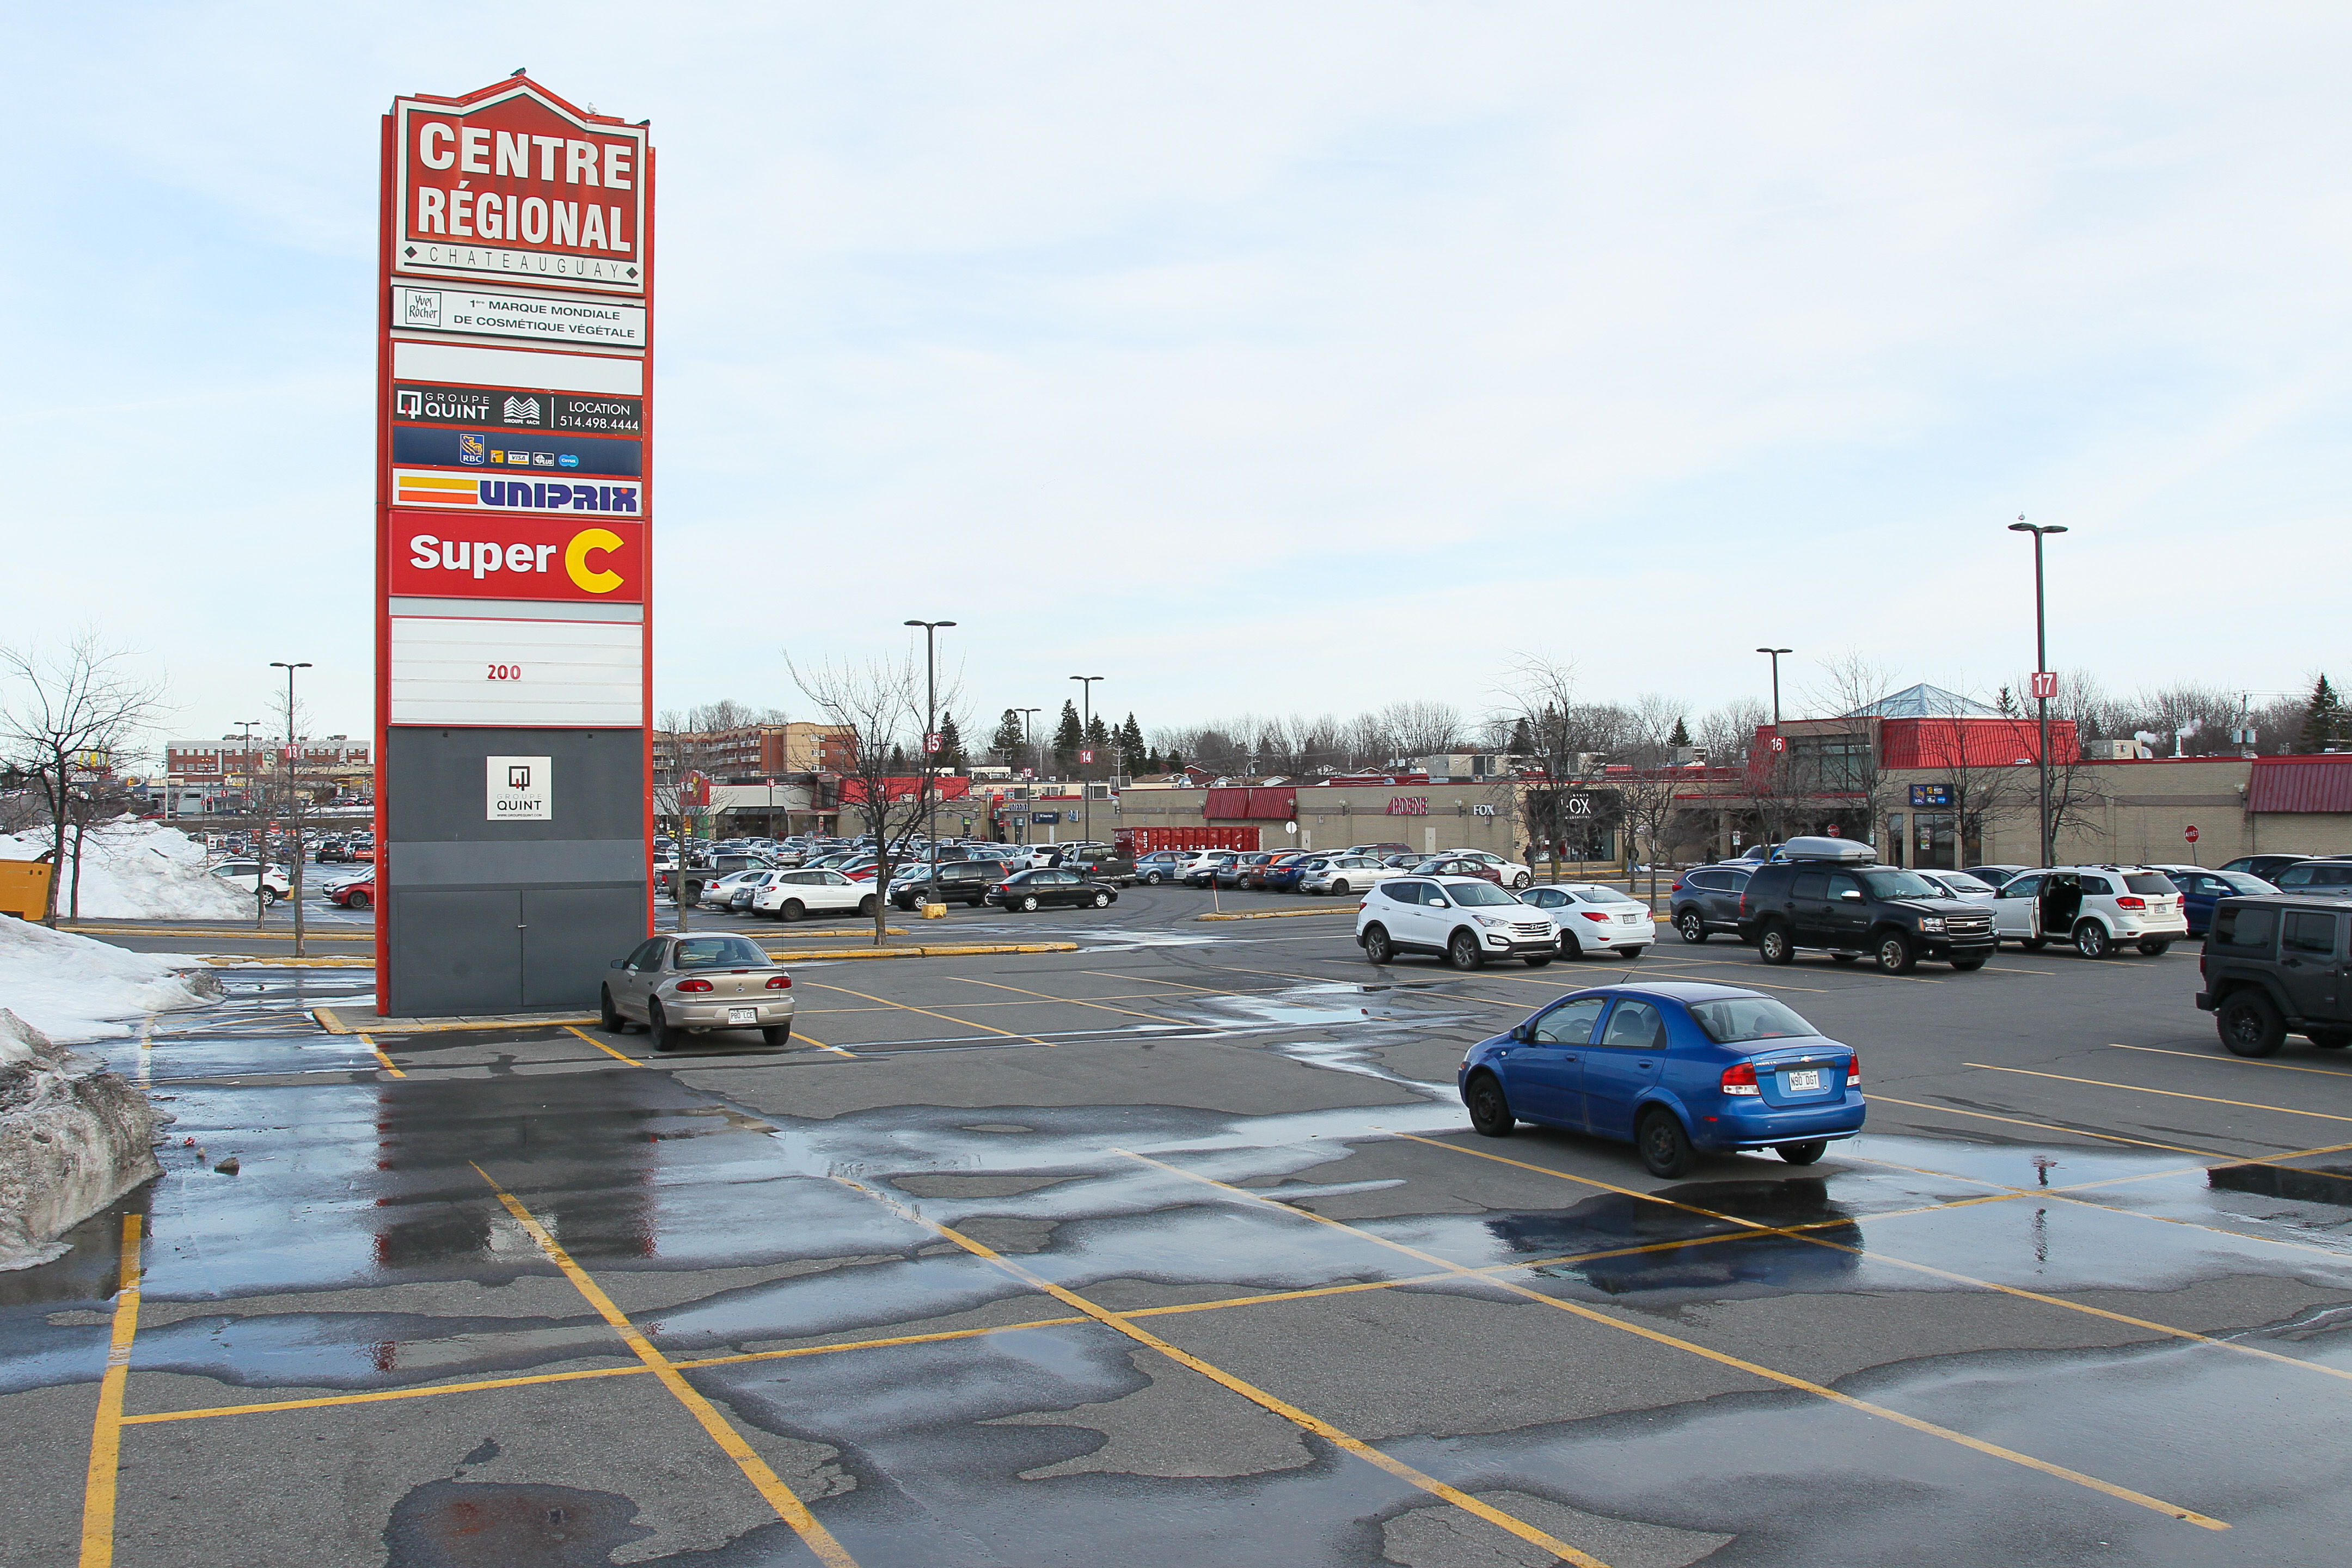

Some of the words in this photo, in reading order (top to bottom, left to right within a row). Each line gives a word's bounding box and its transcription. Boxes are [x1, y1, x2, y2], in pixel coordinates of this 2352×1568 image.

[419, 121, 632, 190] CENTRE
[418, 180, 631, 252] RÉGIONAL
[430, 247, 618, 278] CHATEAUGUAY
[415, 295, 432, 308] Yves
[409, 305, 438, 318] Rocher
[489, 301, 547, 314] MARQUE
[551, 306, 620, 320] MONDIALE
[454, 315, 472, 324] DE
[476, 317, 565, 332] COSMÉTIQUE
[568, 323, 635, 338] VÉGÉTALE
[425, 392, 489, 405] GROUPE
[425, 402, 489, 420] QUINT
[569, 401, 630, 415] LOCATION
[560, 415, 639, 431] 514.498.4444
[480, 480, 636, 512] UNIPRIX
[409, 534, 556, 579] Super
[565, 528, 624, 593] C
[487, 665, 521, 679] 200
[2035, 673, 2053, 695] 17
[928, 734, 941, 750] 15
[1771, 737, 1782, 751] 16
[287, 745, 297, 758] 13
[1082, 751, 1092, 762] 14
[1024, 768, 1032, 777] 12
[497, 800, 542, 810] QUINT
[1385, 797, 1428, 815] ARDENE
[1473, 805, 1495, 816] FOX
[1560, 798, 1591, 814] OX
[1791, 1076, 1802, 1086] N90
[1805, 1075, 1817, 1085] DGT
